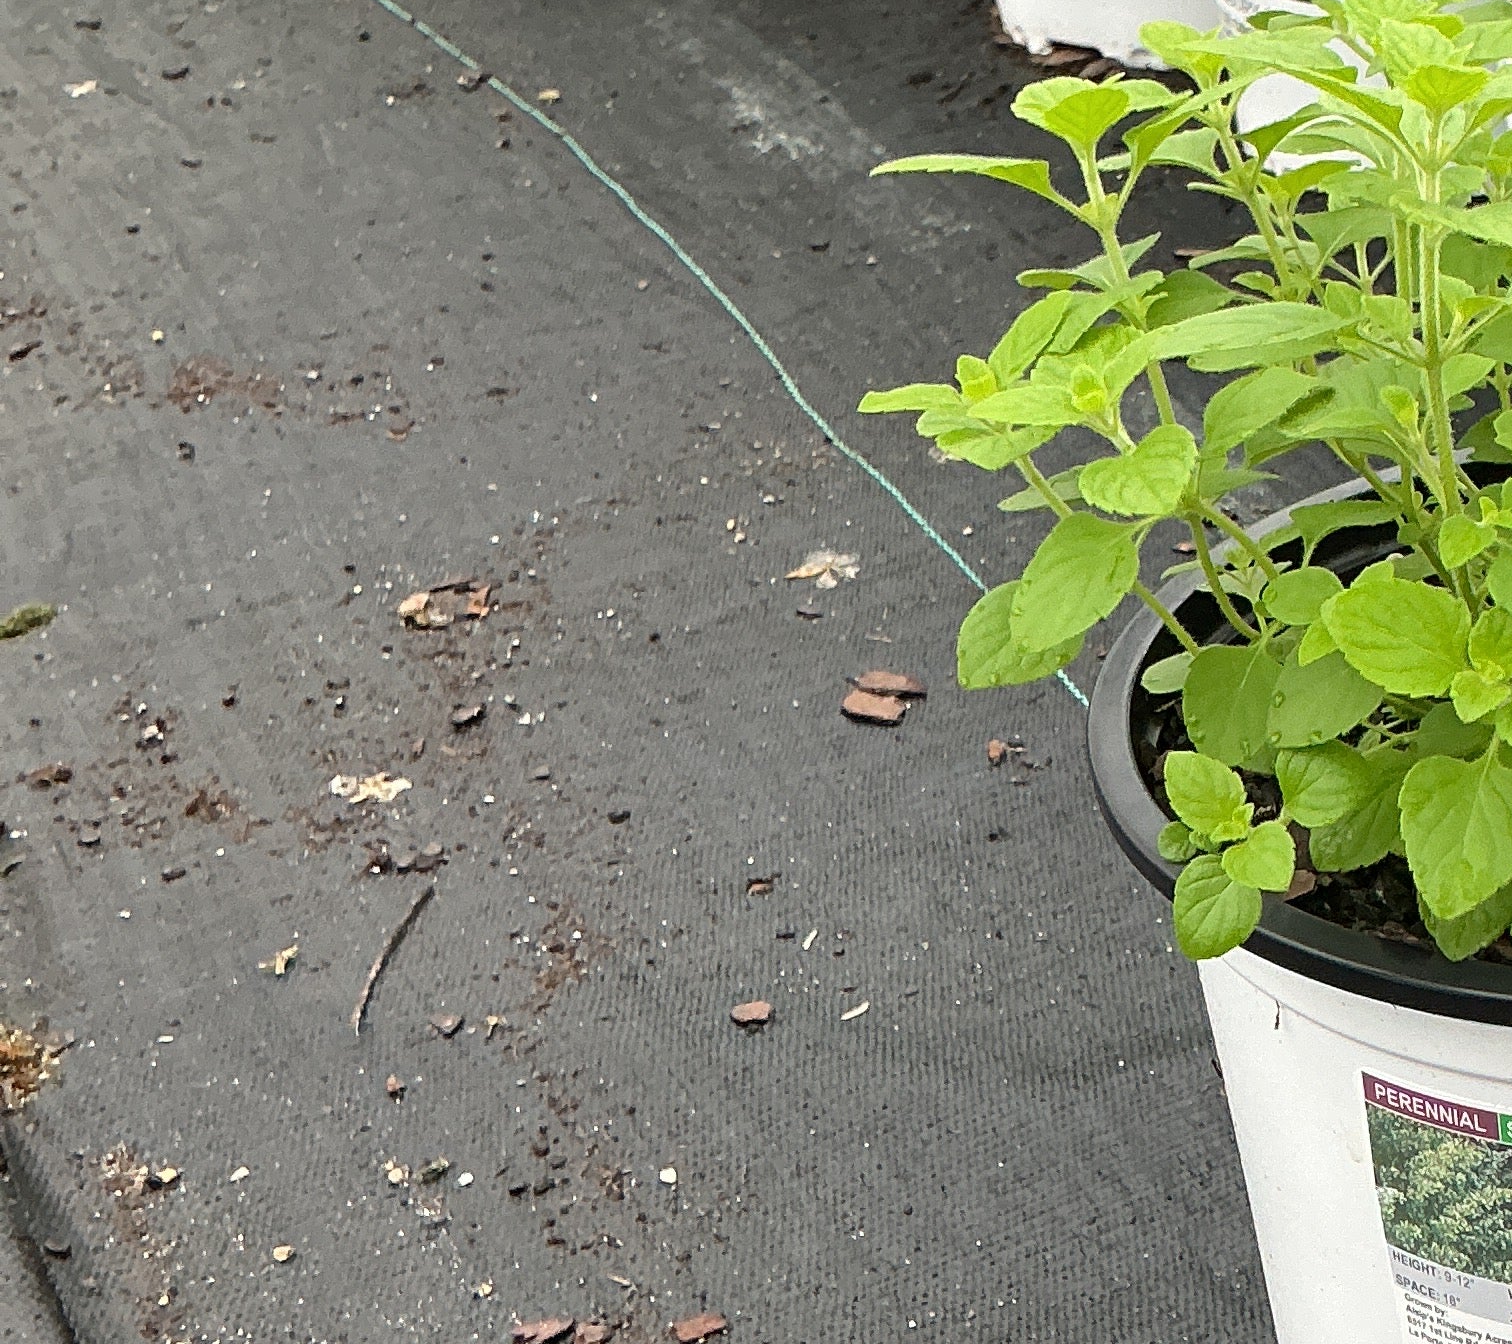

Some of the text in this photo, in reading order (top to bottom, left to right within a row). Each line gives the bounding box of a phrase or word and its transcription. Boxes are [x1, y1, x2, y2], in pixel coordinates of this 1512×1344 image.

[1374, 1082, 1487, 1133] PERENNIAL
[1392, 1250, 1442, 1278] HEIGHT:
[1395, 1273, 1441, 1301] SPACE:
[1436, 1317, 1483, 1340] Kingsbury
